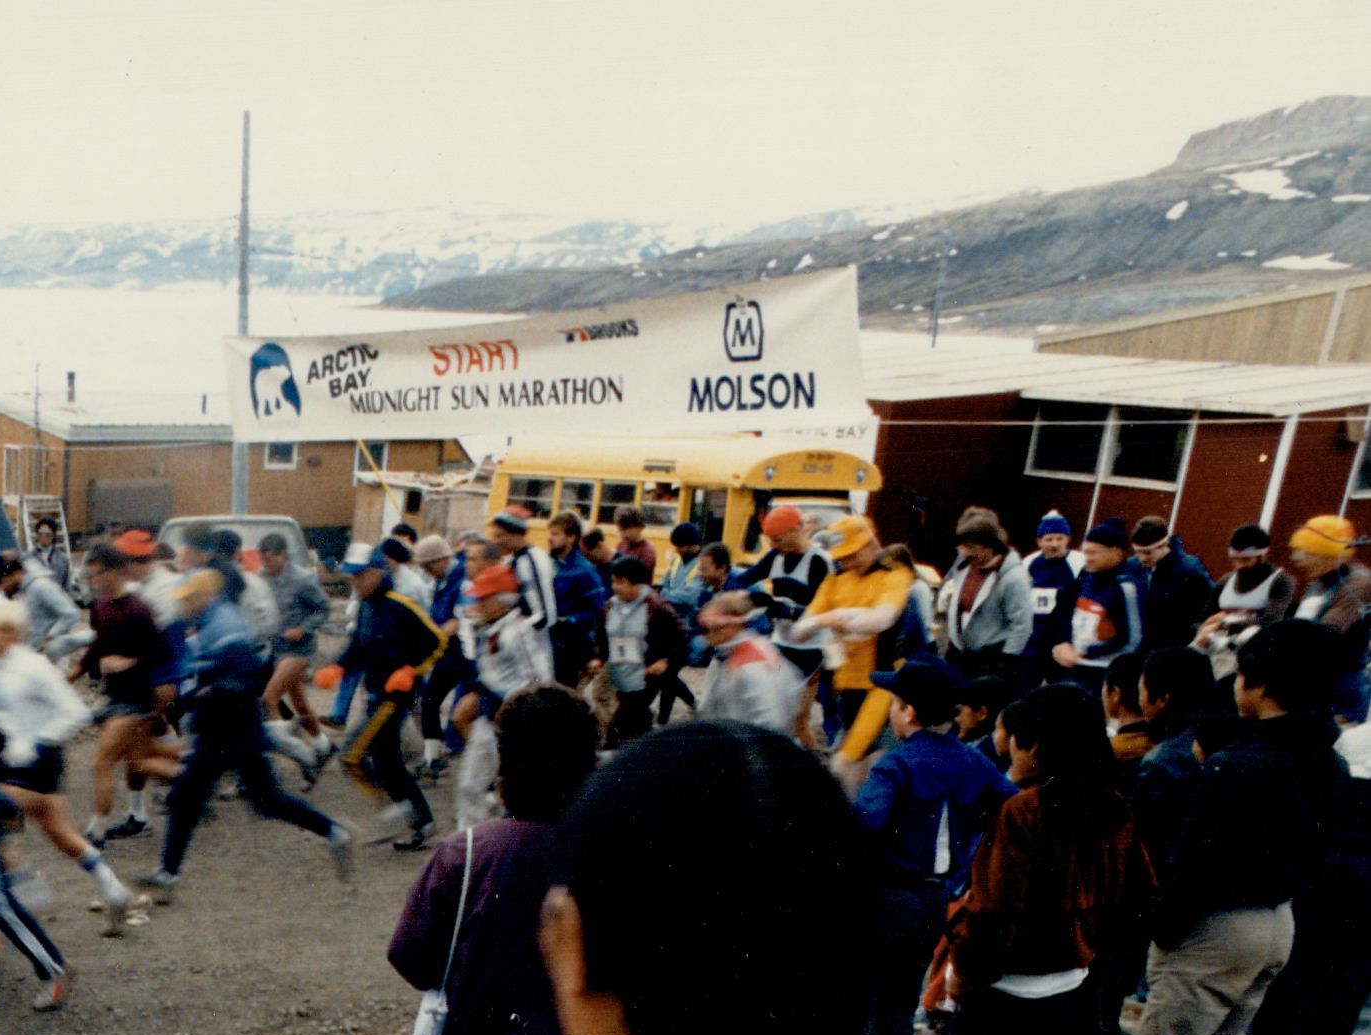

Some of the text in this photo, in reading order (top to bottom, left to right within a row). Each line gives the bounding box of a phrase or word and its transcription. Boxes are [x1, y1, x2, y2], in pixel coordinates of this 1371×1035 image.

[307, 343, 380, 384] ARCTIC
[430, 340, 520, 376] START
[330, 370, 372, 400] BAY
[350, 376, 624, 415] MIDNIGHT SUN MARATHON
[687, 371, 816, 413] MOLSON
